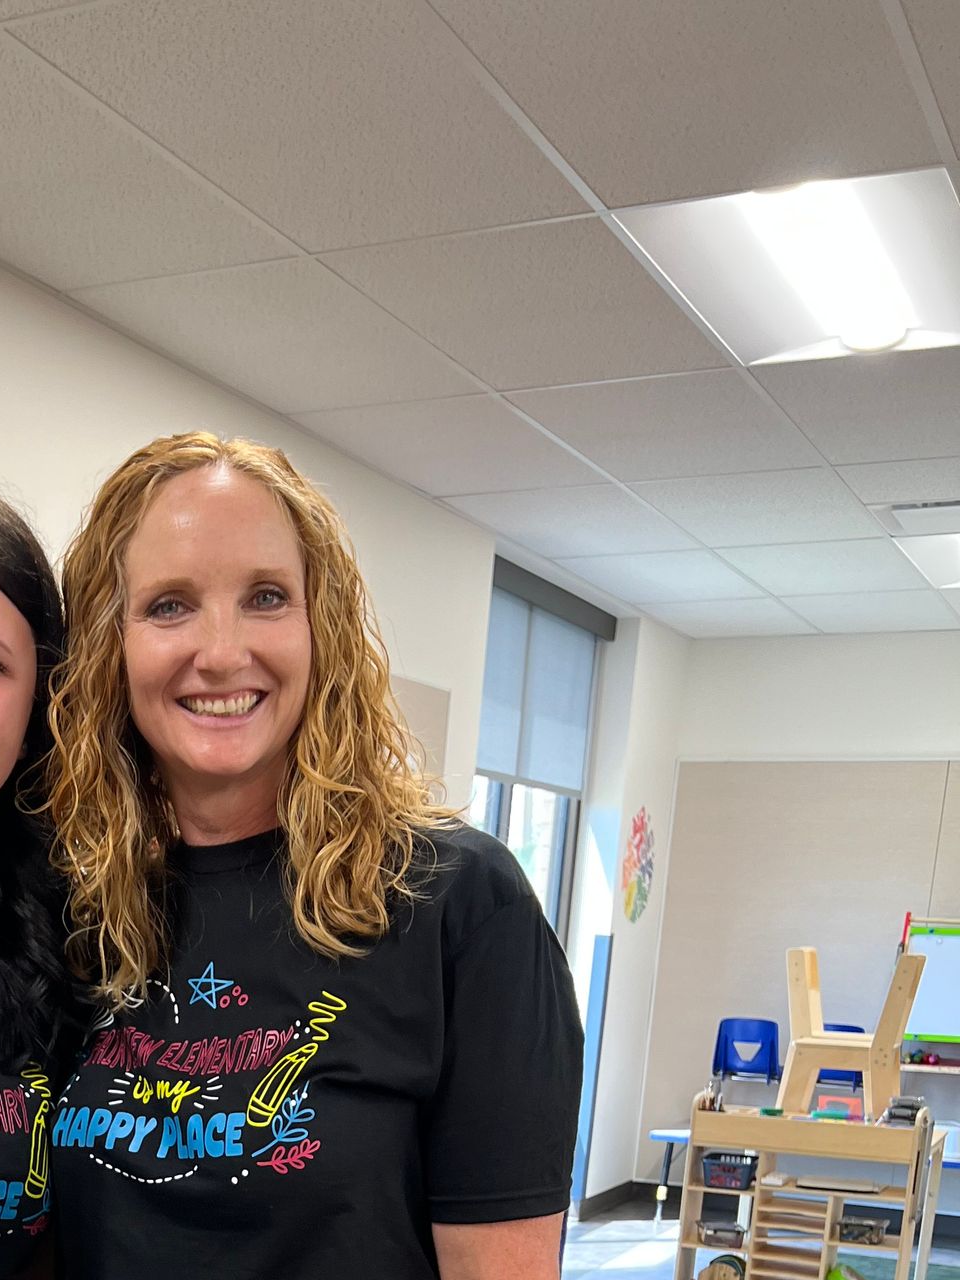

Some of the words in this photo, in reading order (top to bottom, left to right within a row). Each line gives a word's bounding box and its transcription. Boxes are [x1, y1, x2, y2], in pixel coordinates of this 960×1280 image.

[156, 1026, 293, 1076] ELEMENTARY
[133, 1075, 154, 1104] is
[156, 1079, 201, 1113] my
[52, 1106, 158, 1153] HAPPY
[156, 1111, 247, 1160] PLACE
